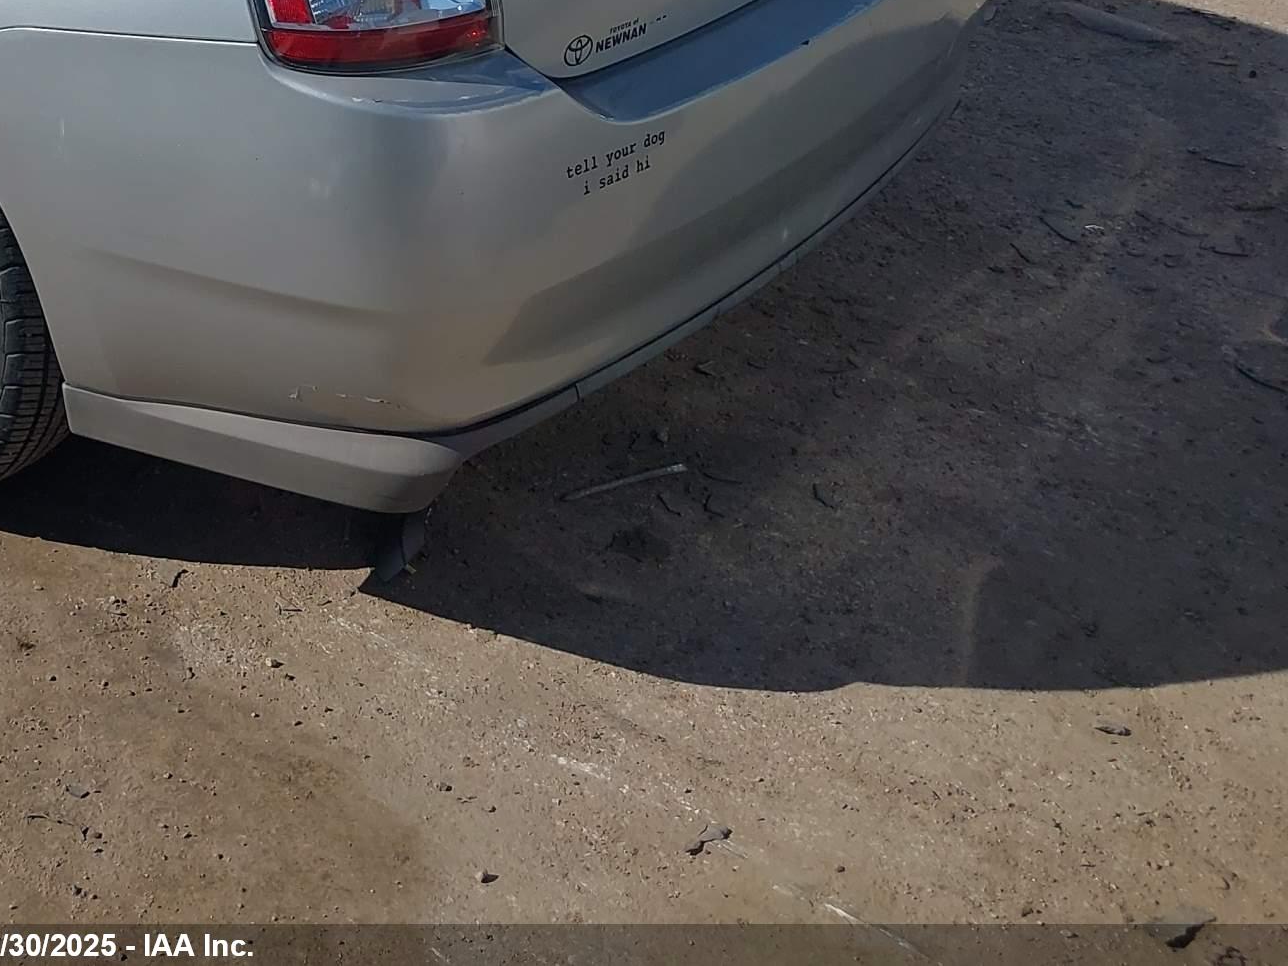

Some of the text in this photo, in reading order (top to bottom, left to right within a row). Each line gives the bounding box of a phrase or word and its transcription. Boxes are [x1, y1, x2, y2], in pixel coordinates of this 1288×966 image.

[595, 23, 647, 53] NEWNAN
[609, 19, 632, 34] TOYOTA
[566, 130, 665, 179] tell your dog
[583, 155, 651, 195] i said hi
